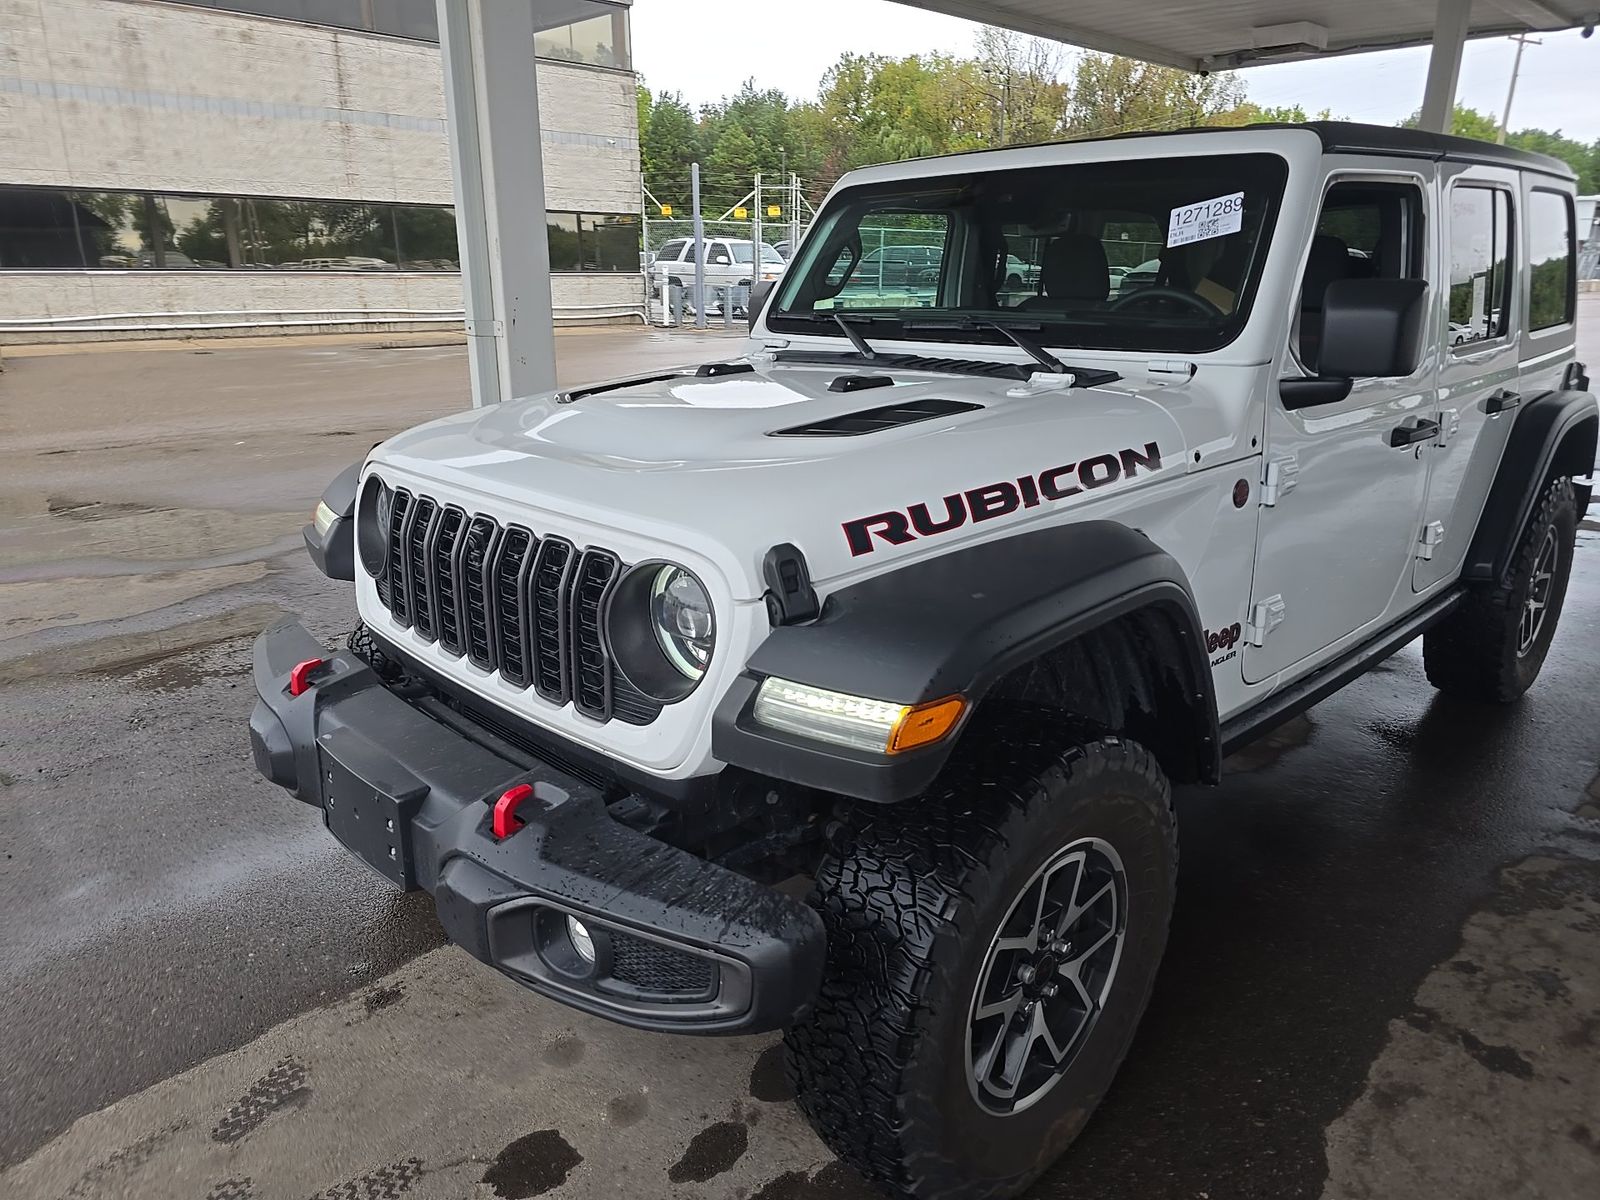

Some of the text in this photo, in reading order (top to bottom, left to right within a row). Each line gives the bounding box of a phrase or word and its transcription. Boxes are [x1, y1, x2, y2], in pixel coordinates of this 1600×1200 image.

[1175, 197, 1243, 226] 1271289
[841, 441, 1162, 557] RUBICON
[1211, 651, 1236, 667] NGLER
